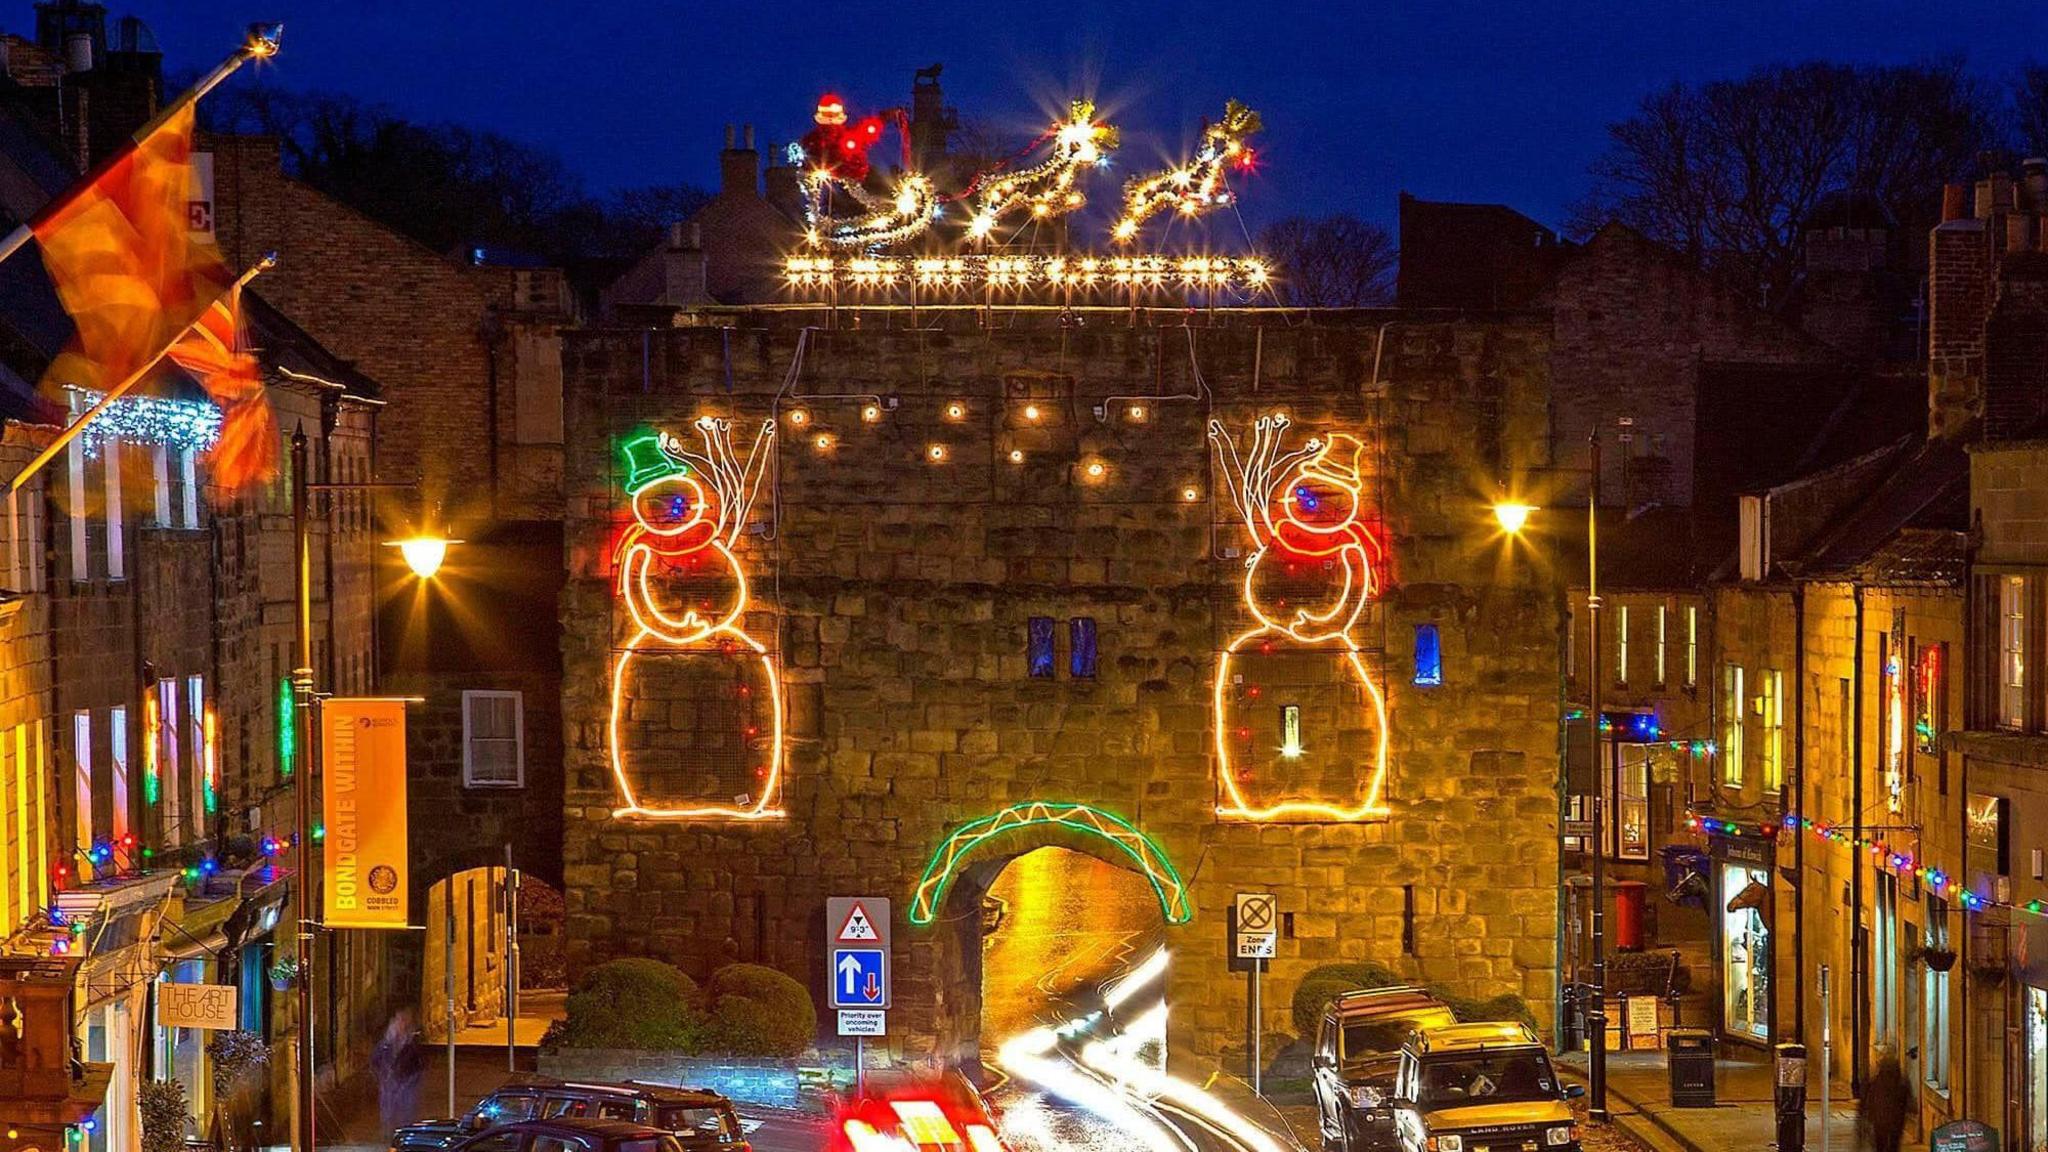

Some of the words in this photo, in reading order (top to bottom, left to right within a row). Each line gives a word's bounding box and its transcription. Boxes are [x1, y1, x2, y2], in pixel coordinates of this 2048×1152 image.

[335, 715, 355, 794] WITHIN
[336, 799, 357, 910] BONDGATE
[163, 986, 198, 1005] THE
[199, 988, 232, 1007] ART
[168, 1001, 227, 1020] HOUSE
[840, 1012, 866, 1020] Priority
[1502, 1124, 1535, 1132] ROVER
